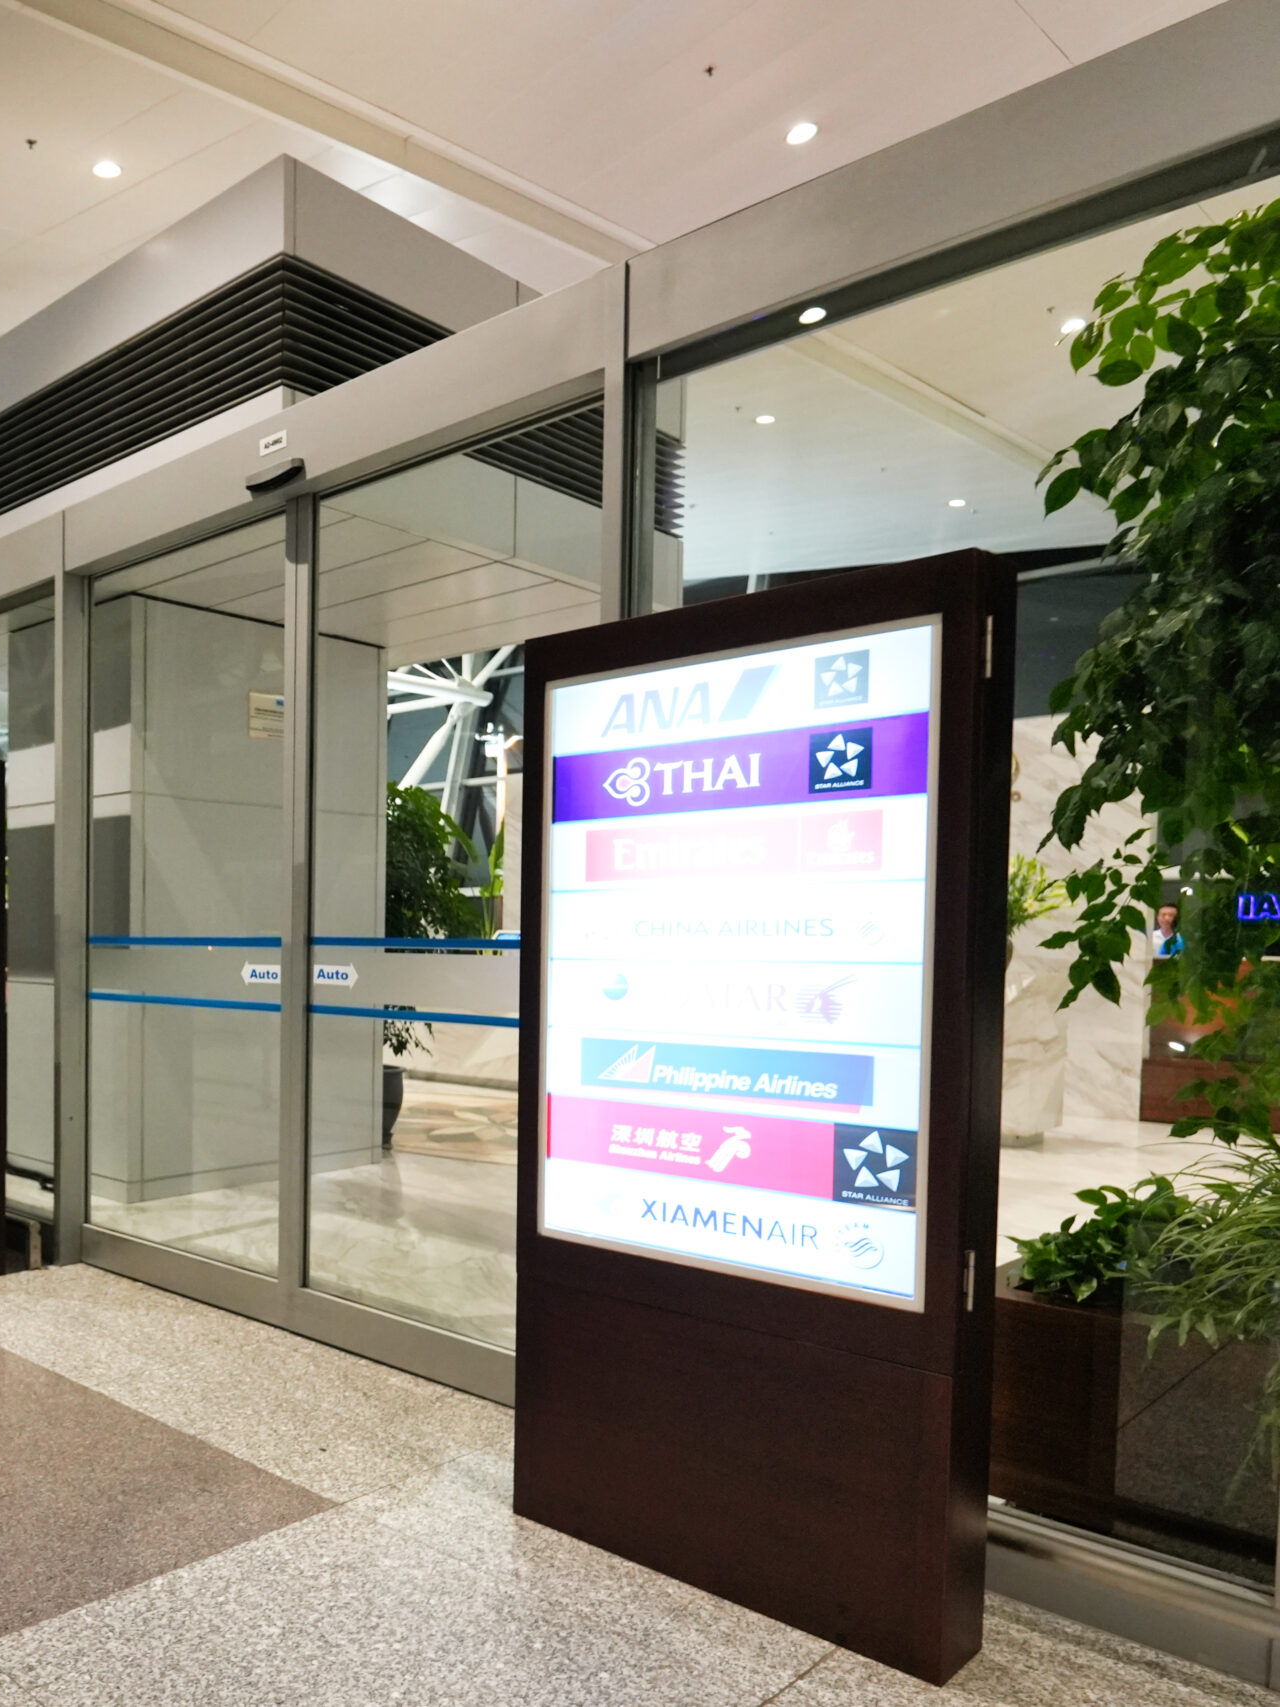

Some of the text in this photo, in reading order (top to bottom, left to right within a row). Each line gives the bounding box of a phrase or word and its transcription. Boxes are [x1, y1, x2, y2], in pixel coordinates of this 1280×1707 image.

[600, 681, 712, 738] ANA
[653, 752, 762, 796] THAI
[612, 832, 767, 871] Emirates
[634, 918, 835, 938] CHINA AIRLINES
[249, 968, 279, 981] Auto
[316, 968, 349, 981] Auto
[652, 1064, 839, 1099] Philippine Airlines
[841, 1190, 909, 1206] STAR ALLIANCE
[641, 1198, 819, 1250] XIAMENAIR
